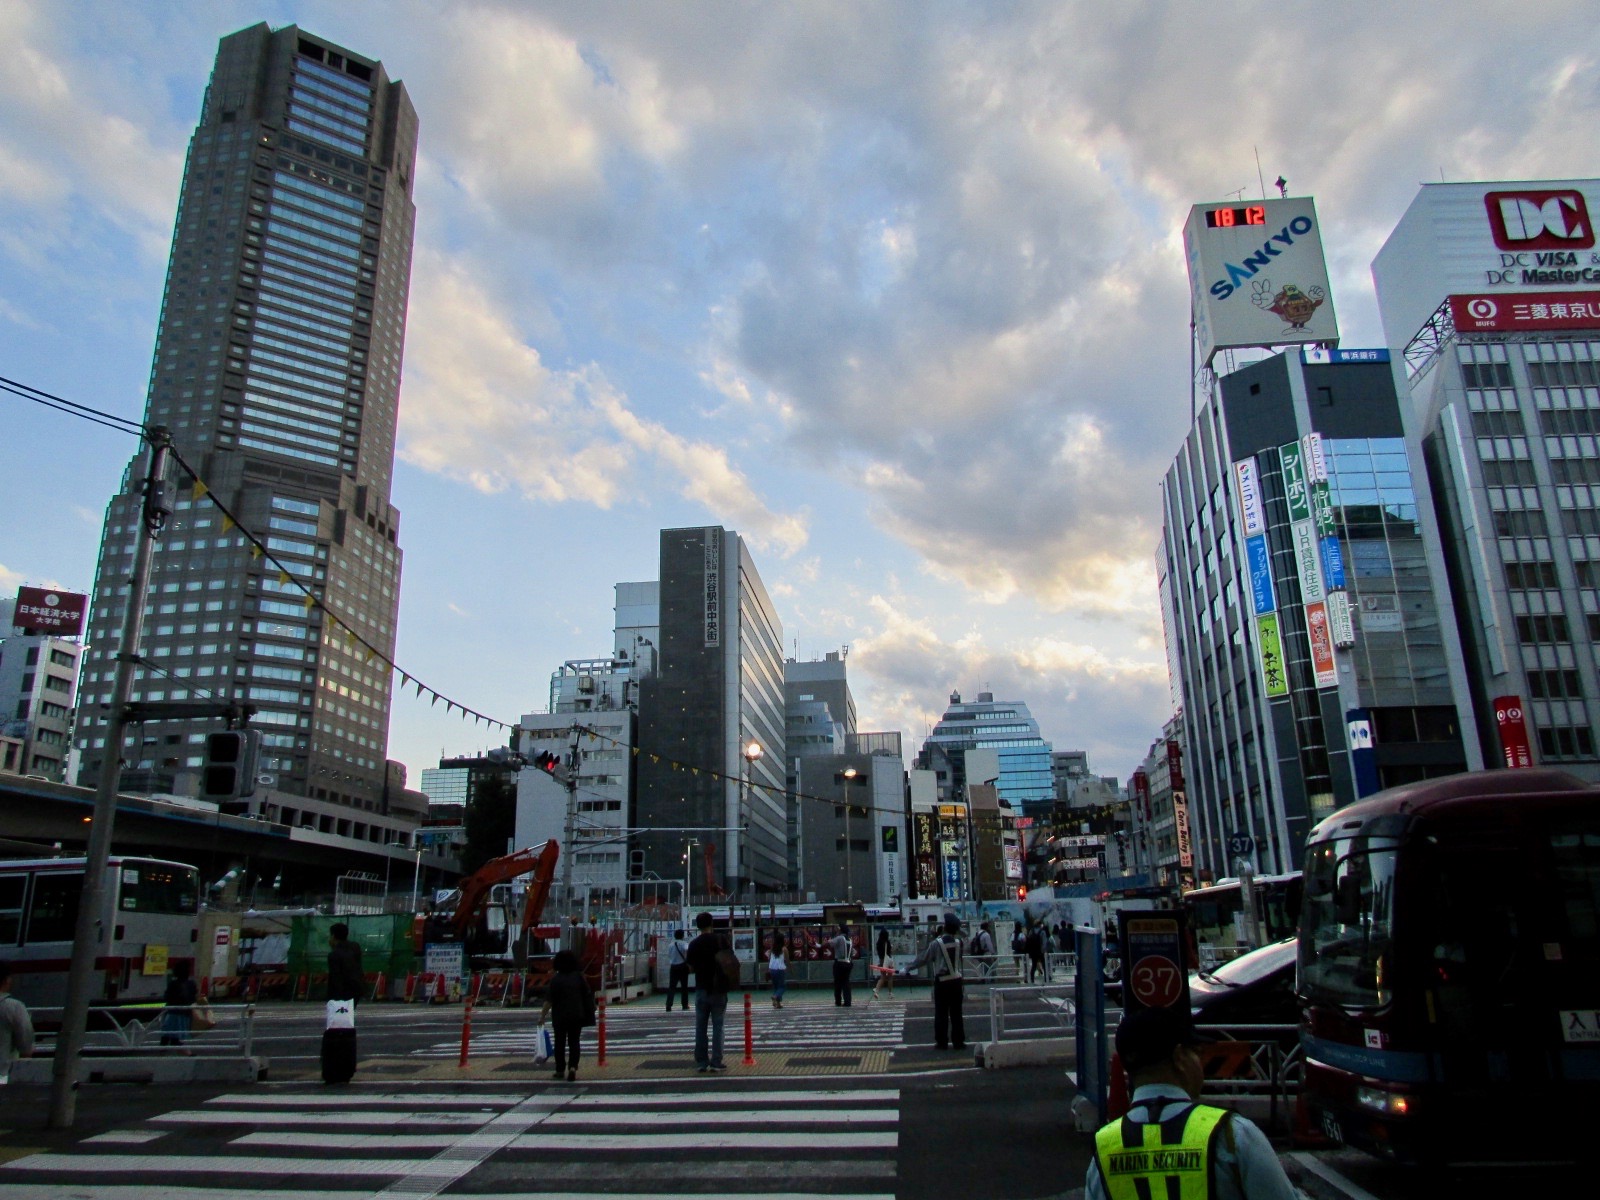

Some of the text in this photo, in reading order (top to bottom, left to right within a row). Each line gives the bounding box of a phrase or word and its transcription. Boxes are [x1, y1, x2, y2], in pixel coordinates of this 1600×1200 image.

[1215, 206, 1266, 227] 18 12
[1499, 197, 1585, 240] DC
[1210, 216, 1312, 300] SANKYO
[1500, 253, 1529, 267] DC
[1535, 252, 1578, 266] VISA
[1486, 270, 1516, 285] DC
[1475, 320, 1496, 328] MUFG
[1341, 351, 1377, 360] 横浜銀行
[1242, 475, 1257, 530] メニコン渋谷
[20, 604, 80, 620] 日本経済大学
[707, 573, 718, 641] 渋谷駅前中央街
[36, 616, 61, 626] 大学院
[1232, 837, 1250, 853] 37
[1137, 967, 1174, 996] 37
[1110, 1152, 1202, 1172] MARINE SECURITY
